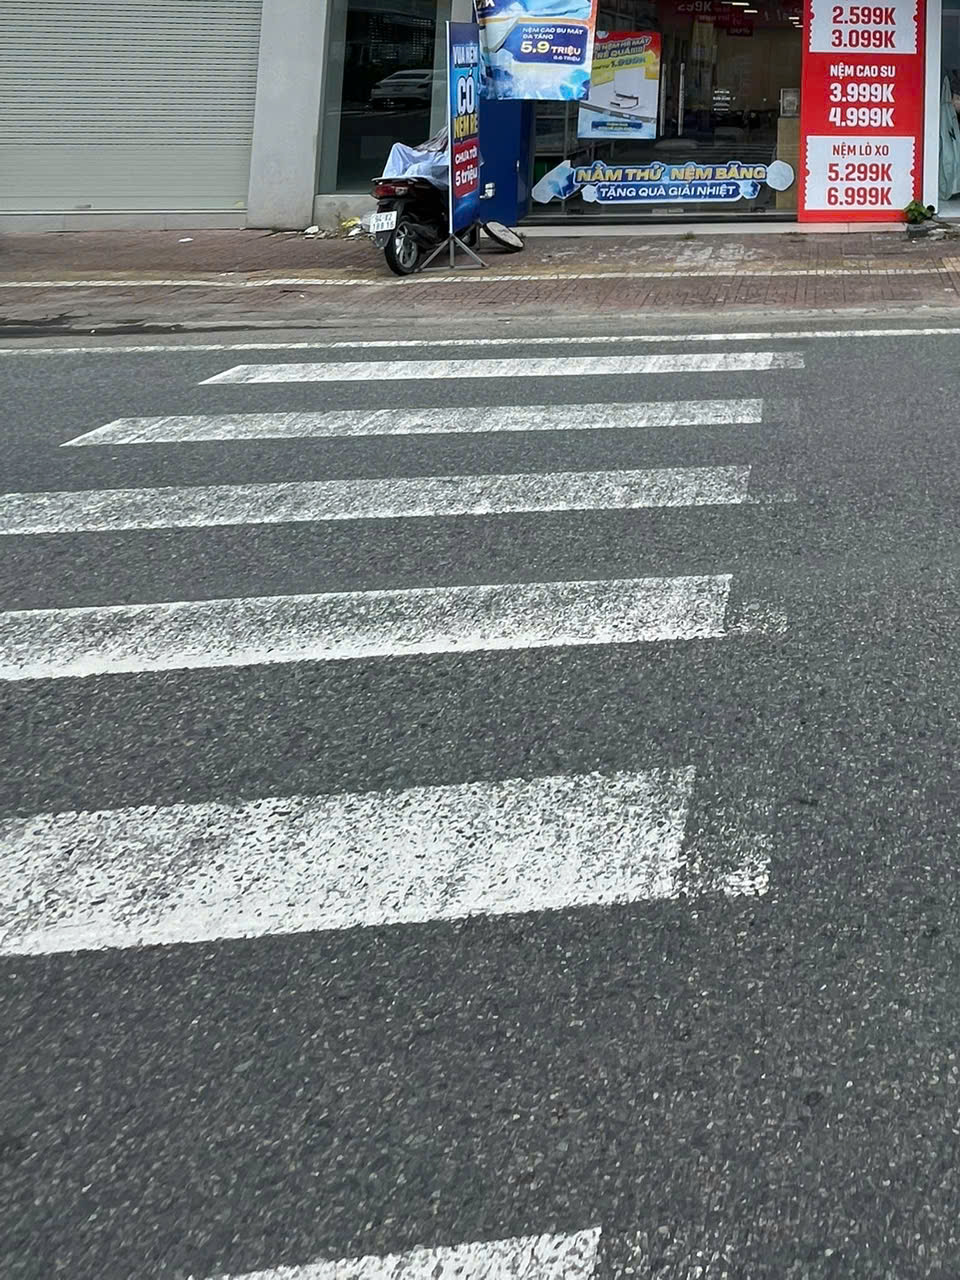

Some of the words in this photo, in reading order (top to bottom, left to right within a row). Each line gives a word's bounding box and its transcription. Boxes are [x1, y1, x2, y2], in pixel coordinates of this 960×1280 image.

[832, 6, 896, 25] 2.599K
[831, 29, 896, 48] 3.099K
[521, 41, 550, 53] 5.9
[551, 45, 581, 56] TRIỆU
[830, 62, 854, 79] NỆM
[856, 65, 878, 77] CAO
[880, 65, 896, 77] SU
[457, 68, 475, 115] CÓ
[829, 82, 895, 103] 3.999K
[829, 107, 895, 127] 4.999K
[832, 142, 856, 159] NỆM
[859, 142, 872, 156] LÒ
[874, 145, 889, 156] XO
[455, 170, 461, 186] 5
[461, 164, 478, 185] triệu
[577, 163, 622, 182] NẰM
[671, 164, 712, 183] NỆM
[715, 163, 767, 180] BĂNG
[828, 163, 892, 182] 5.299K
[600, 183, 636, 199] TẶNG
[638, 184, 666, 197] QUÀ
[669, 183, 695, 196] GIẢI
[697, 182, 736, 198] NHIỆT
[827, 187, 892, 206] 6.999K
